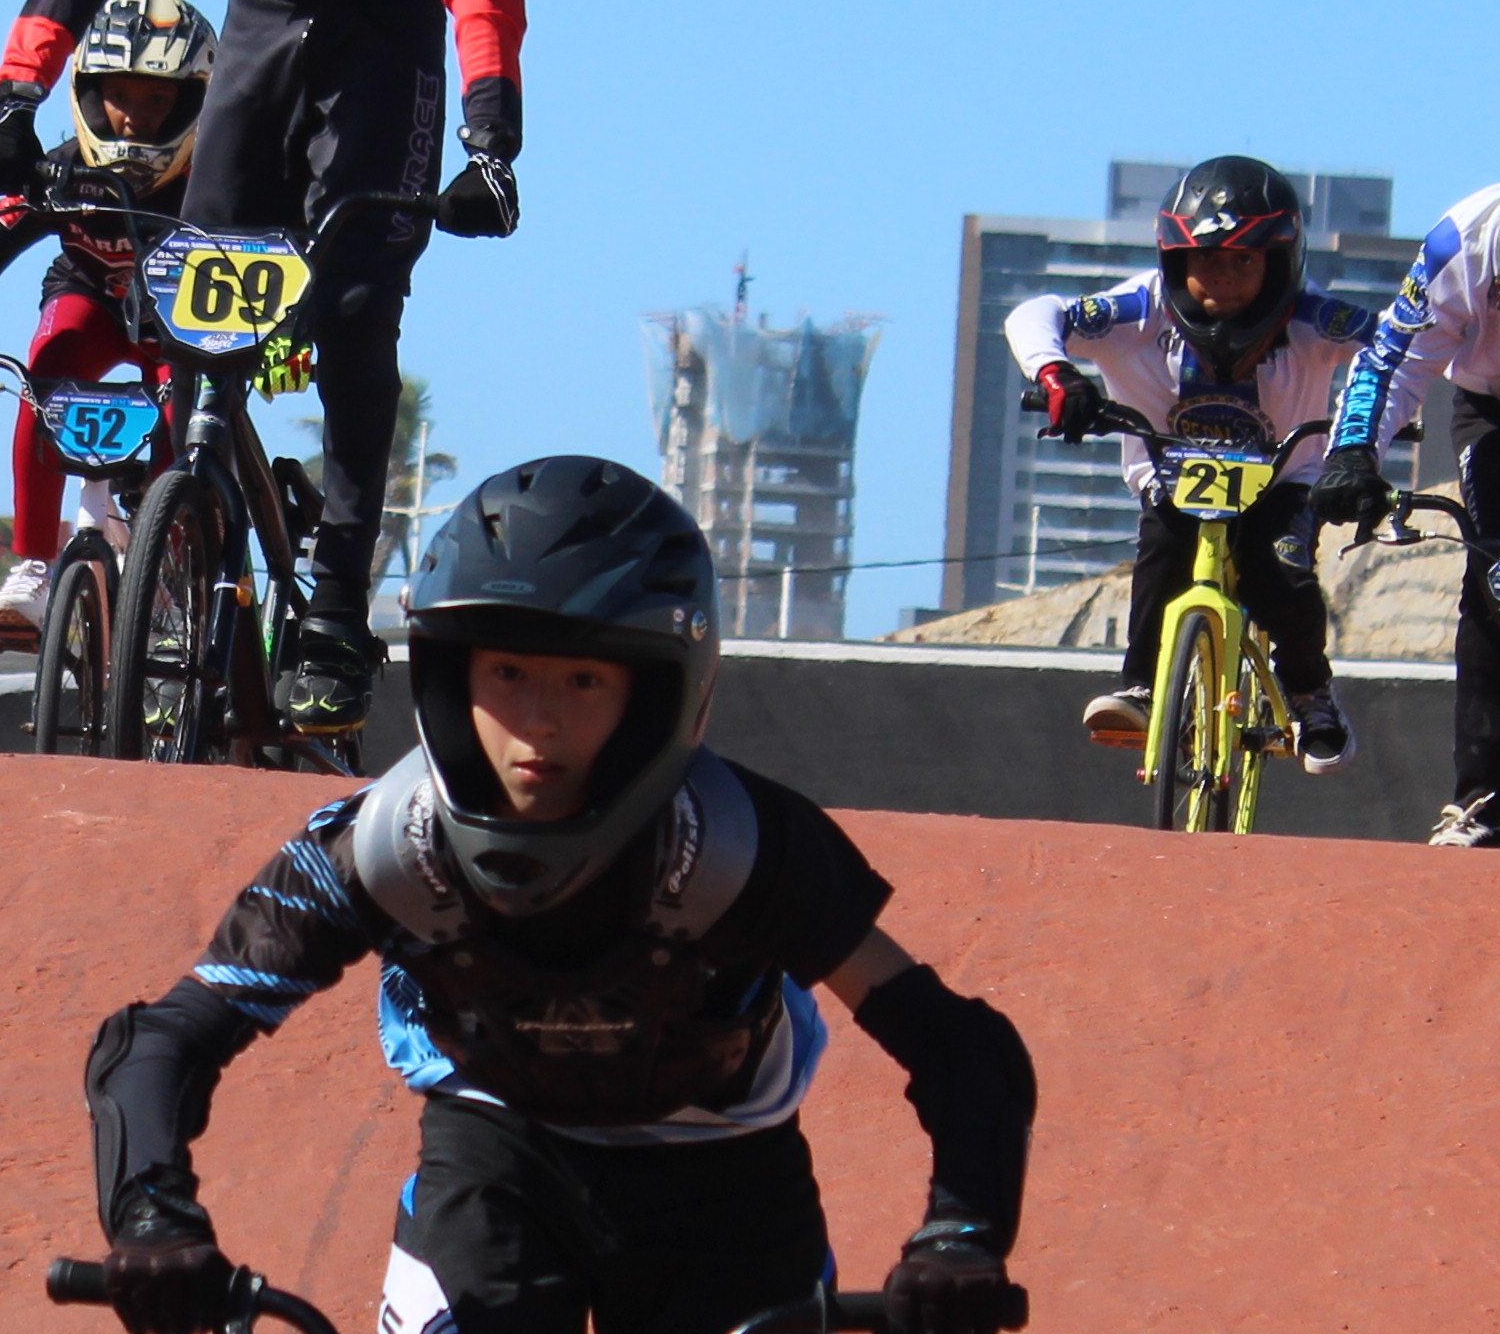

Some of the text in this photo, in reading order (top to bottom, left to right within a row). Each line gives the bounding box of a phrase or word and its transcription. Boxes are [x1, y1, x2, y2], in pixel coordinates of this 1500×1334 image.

[190, 257, 285, 325] 69
[75, 407, 127, 450] 52
[1185, 462, 1244, 507] 21
